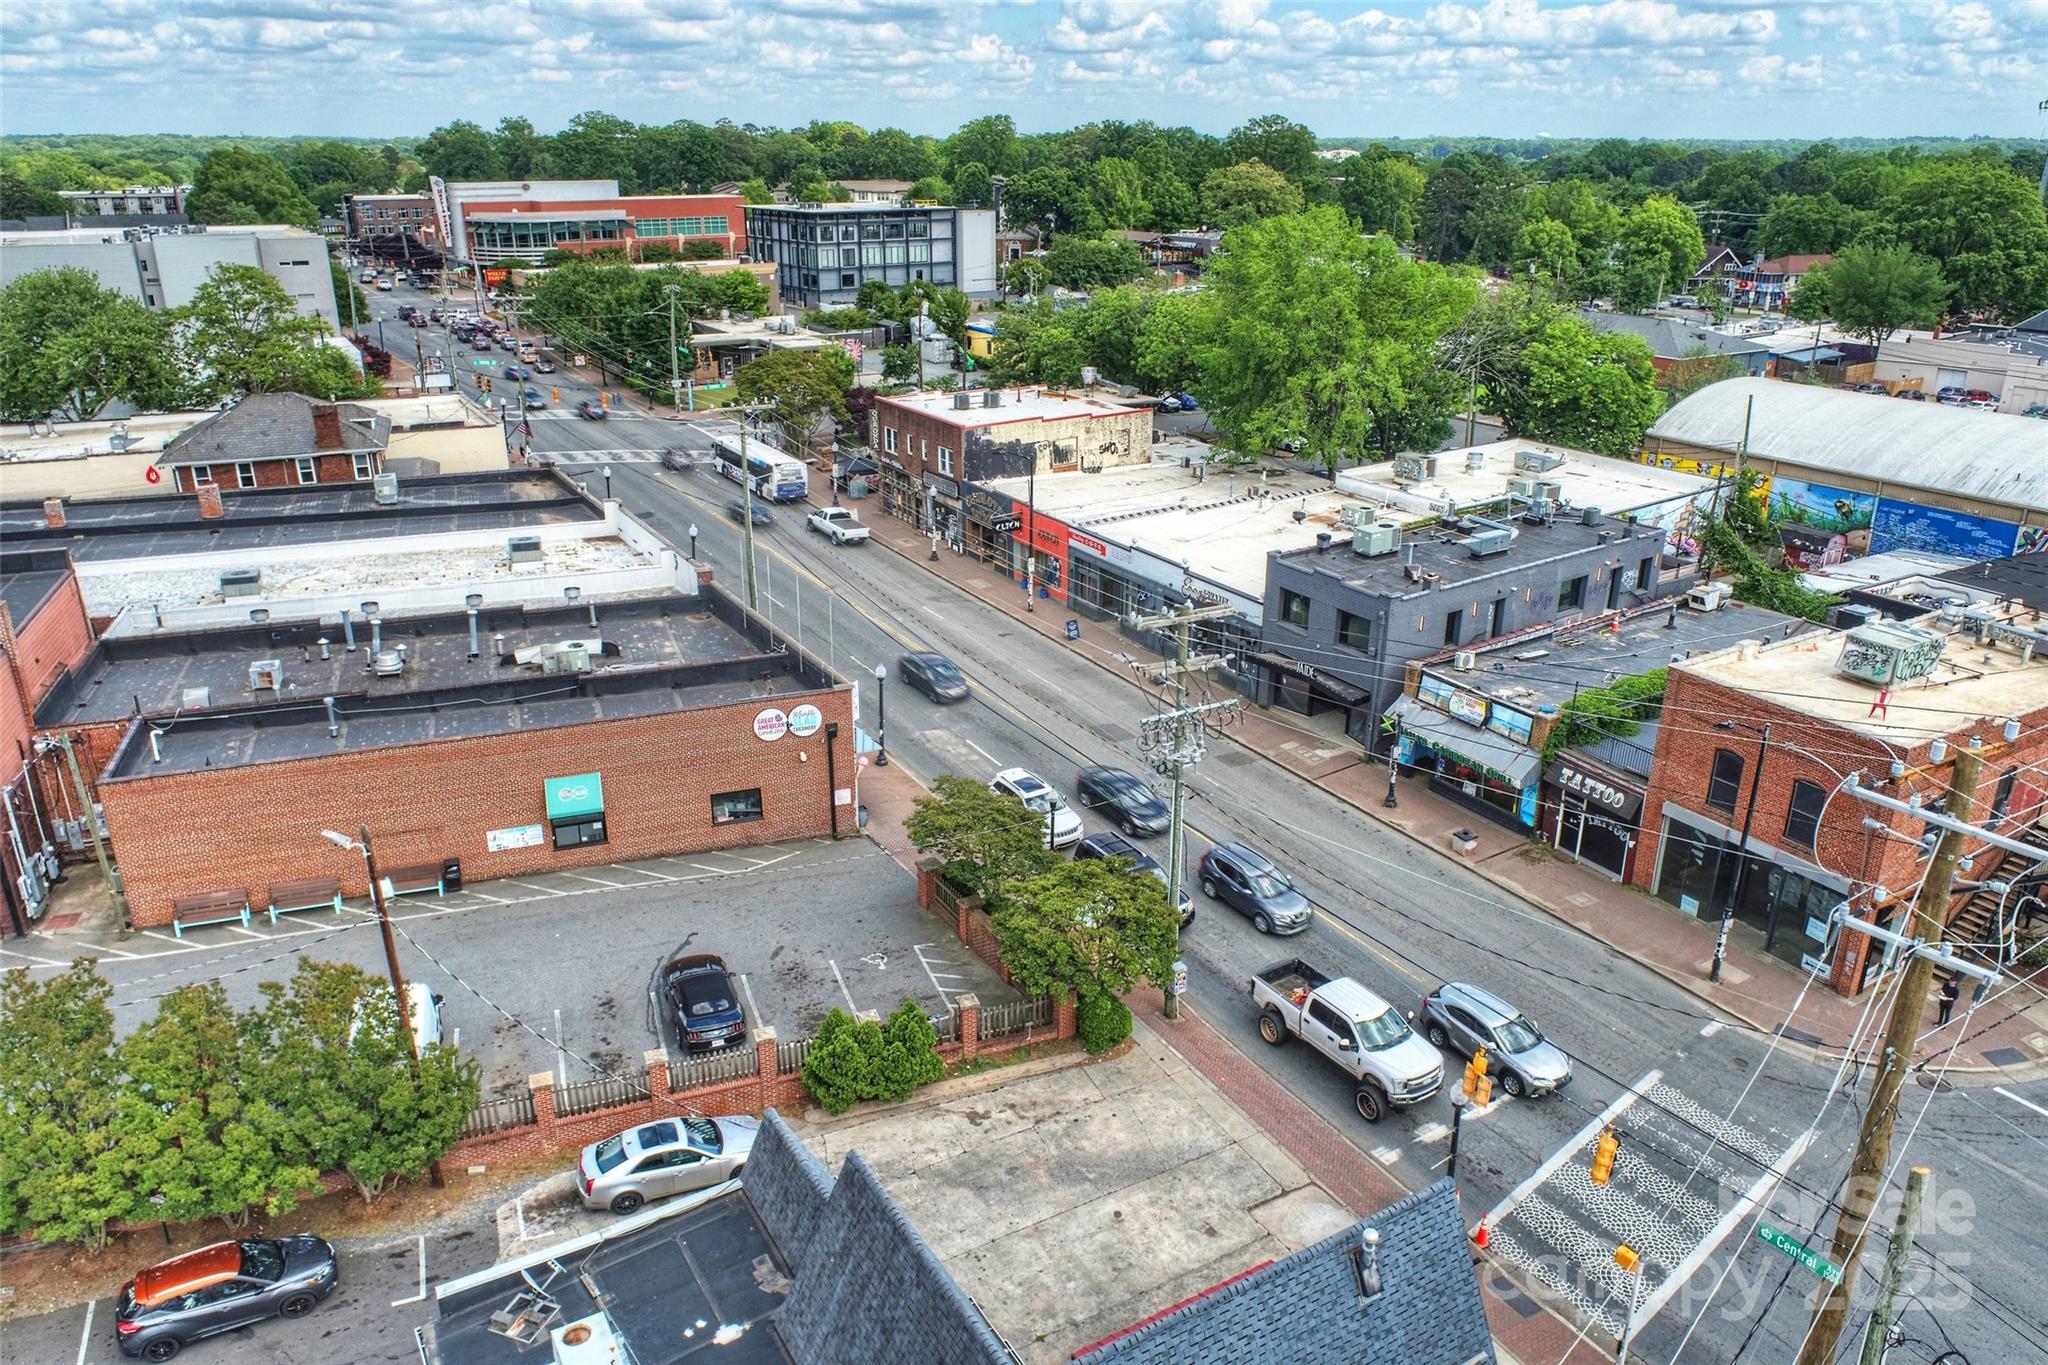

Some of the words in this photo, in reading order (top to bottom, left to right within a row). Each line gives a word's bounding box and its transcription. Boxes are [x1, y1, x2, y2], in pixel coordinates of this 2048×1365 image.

[757, 722, 785, 731] AMERICAN
[1560, 767, 1624, 807] TATTOO
[1776, 1235, 1817, 1269] Central
